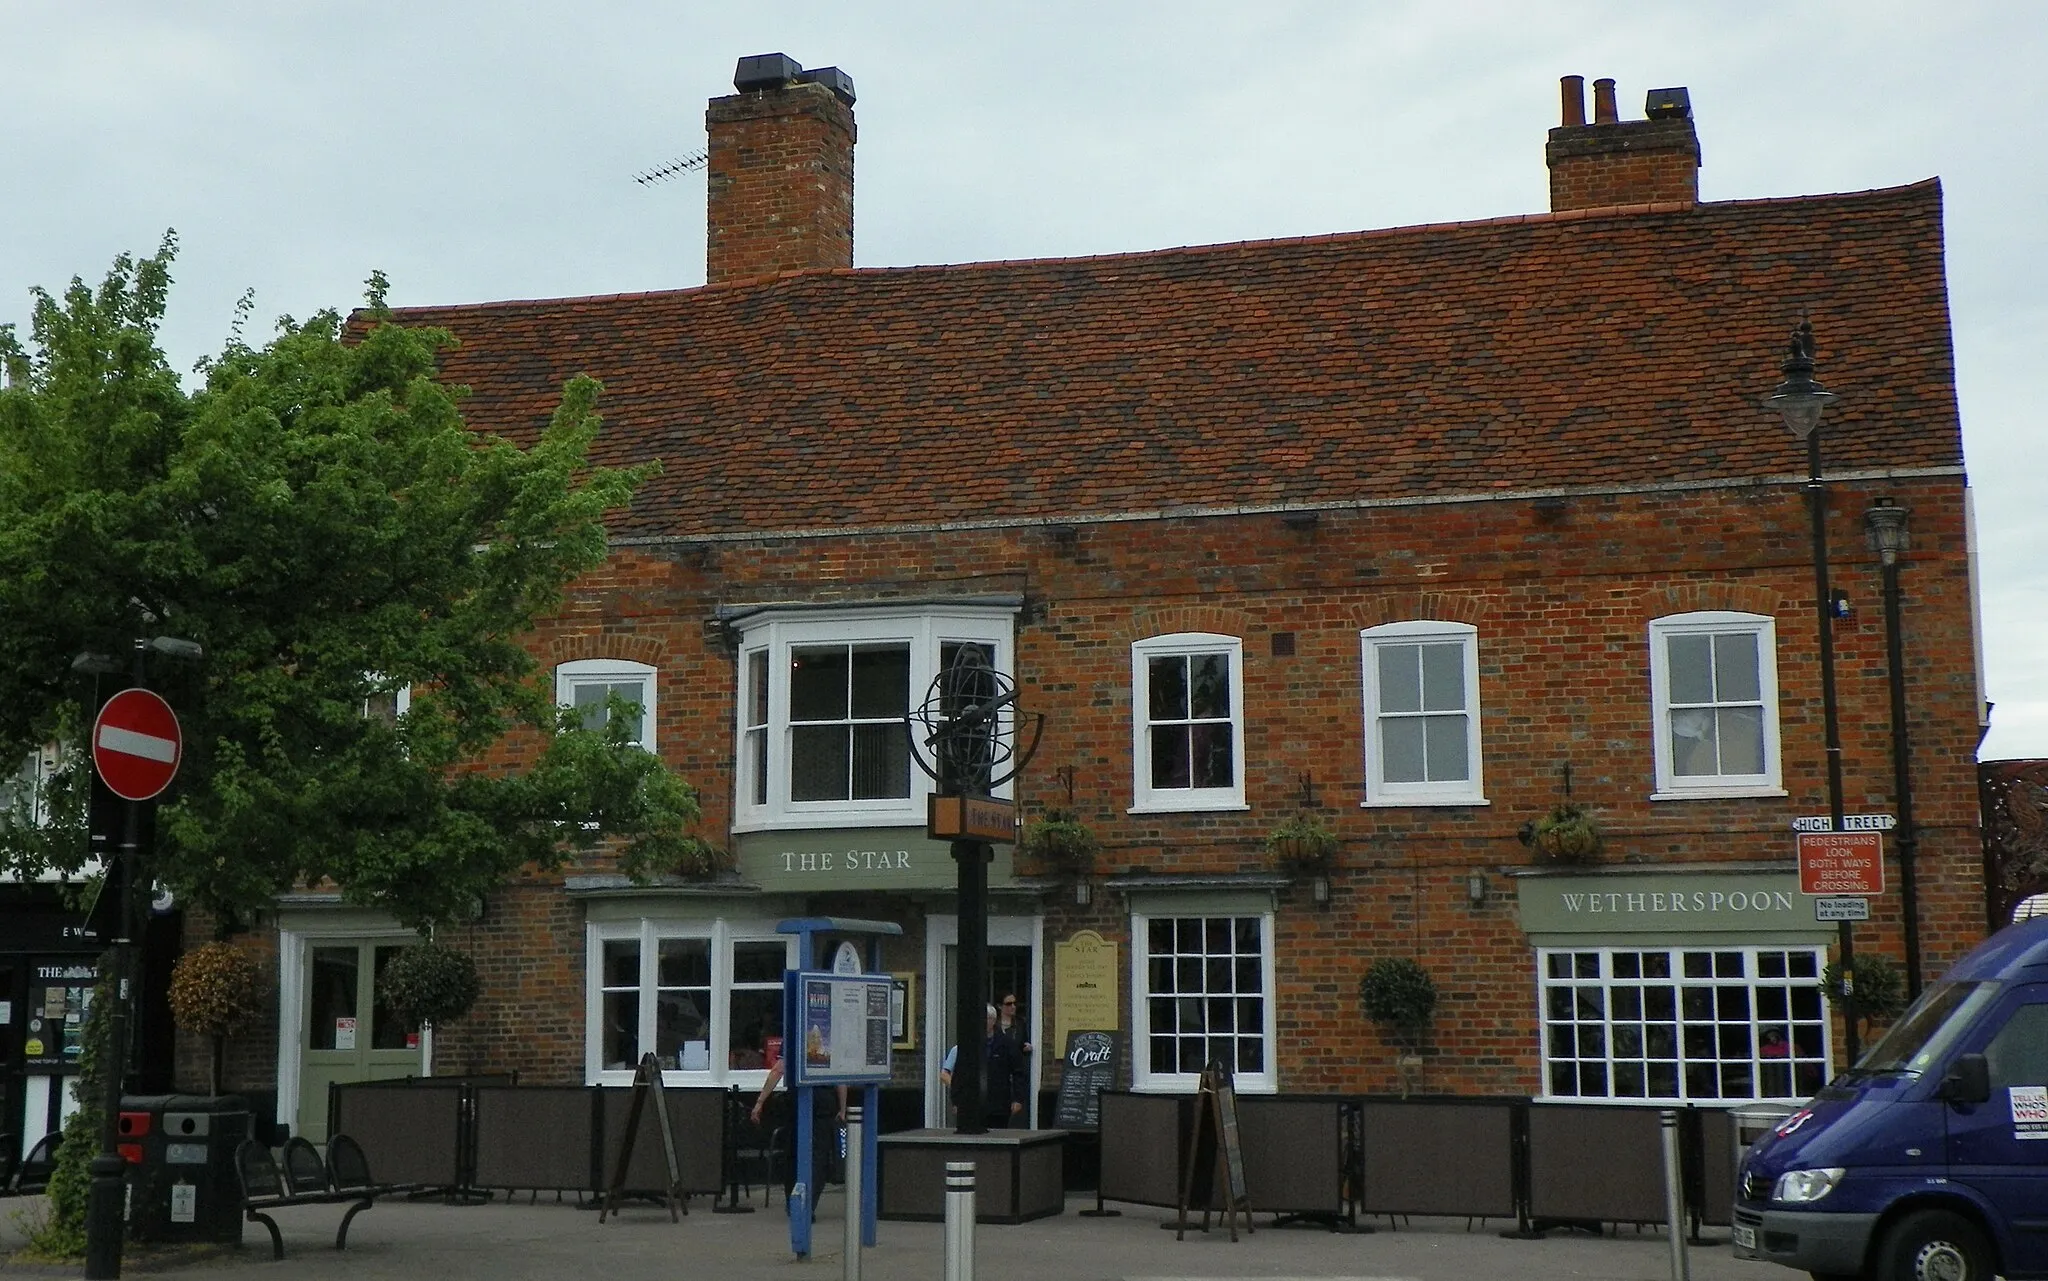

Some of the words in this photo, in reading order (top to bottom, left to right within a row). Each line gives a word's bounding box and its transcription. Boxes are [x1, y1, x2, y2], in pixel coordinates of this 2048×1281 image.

[1799, 818, 1830, 830] HIGH
[1845, 817, 1887, 828] TREET
[1803, 837, 1876, 847] PEDESTRIANS
[1826, 848, 1854, 857] LOOK
[781, 852, 833, 871] THE
[846, 850, 911, 869] STAR
[1809, 860, 1838, 869] BOTH
[1843, 859, 1872, 868] WAYS
[1821, 870, 1861, 879] BEFORE
[1814, 881, 1870, 890] CROSSING
[1561, 891, 1794, 912] WETHERSPOON
[1834, 901, 1866, 910] loading
[1831, 910, 1846, 918] any
[38, 966, 63, 978] THE
[1070, 1047, 1112, 1067] Craft
[2014, 1109, 2047, 1118] WHO
